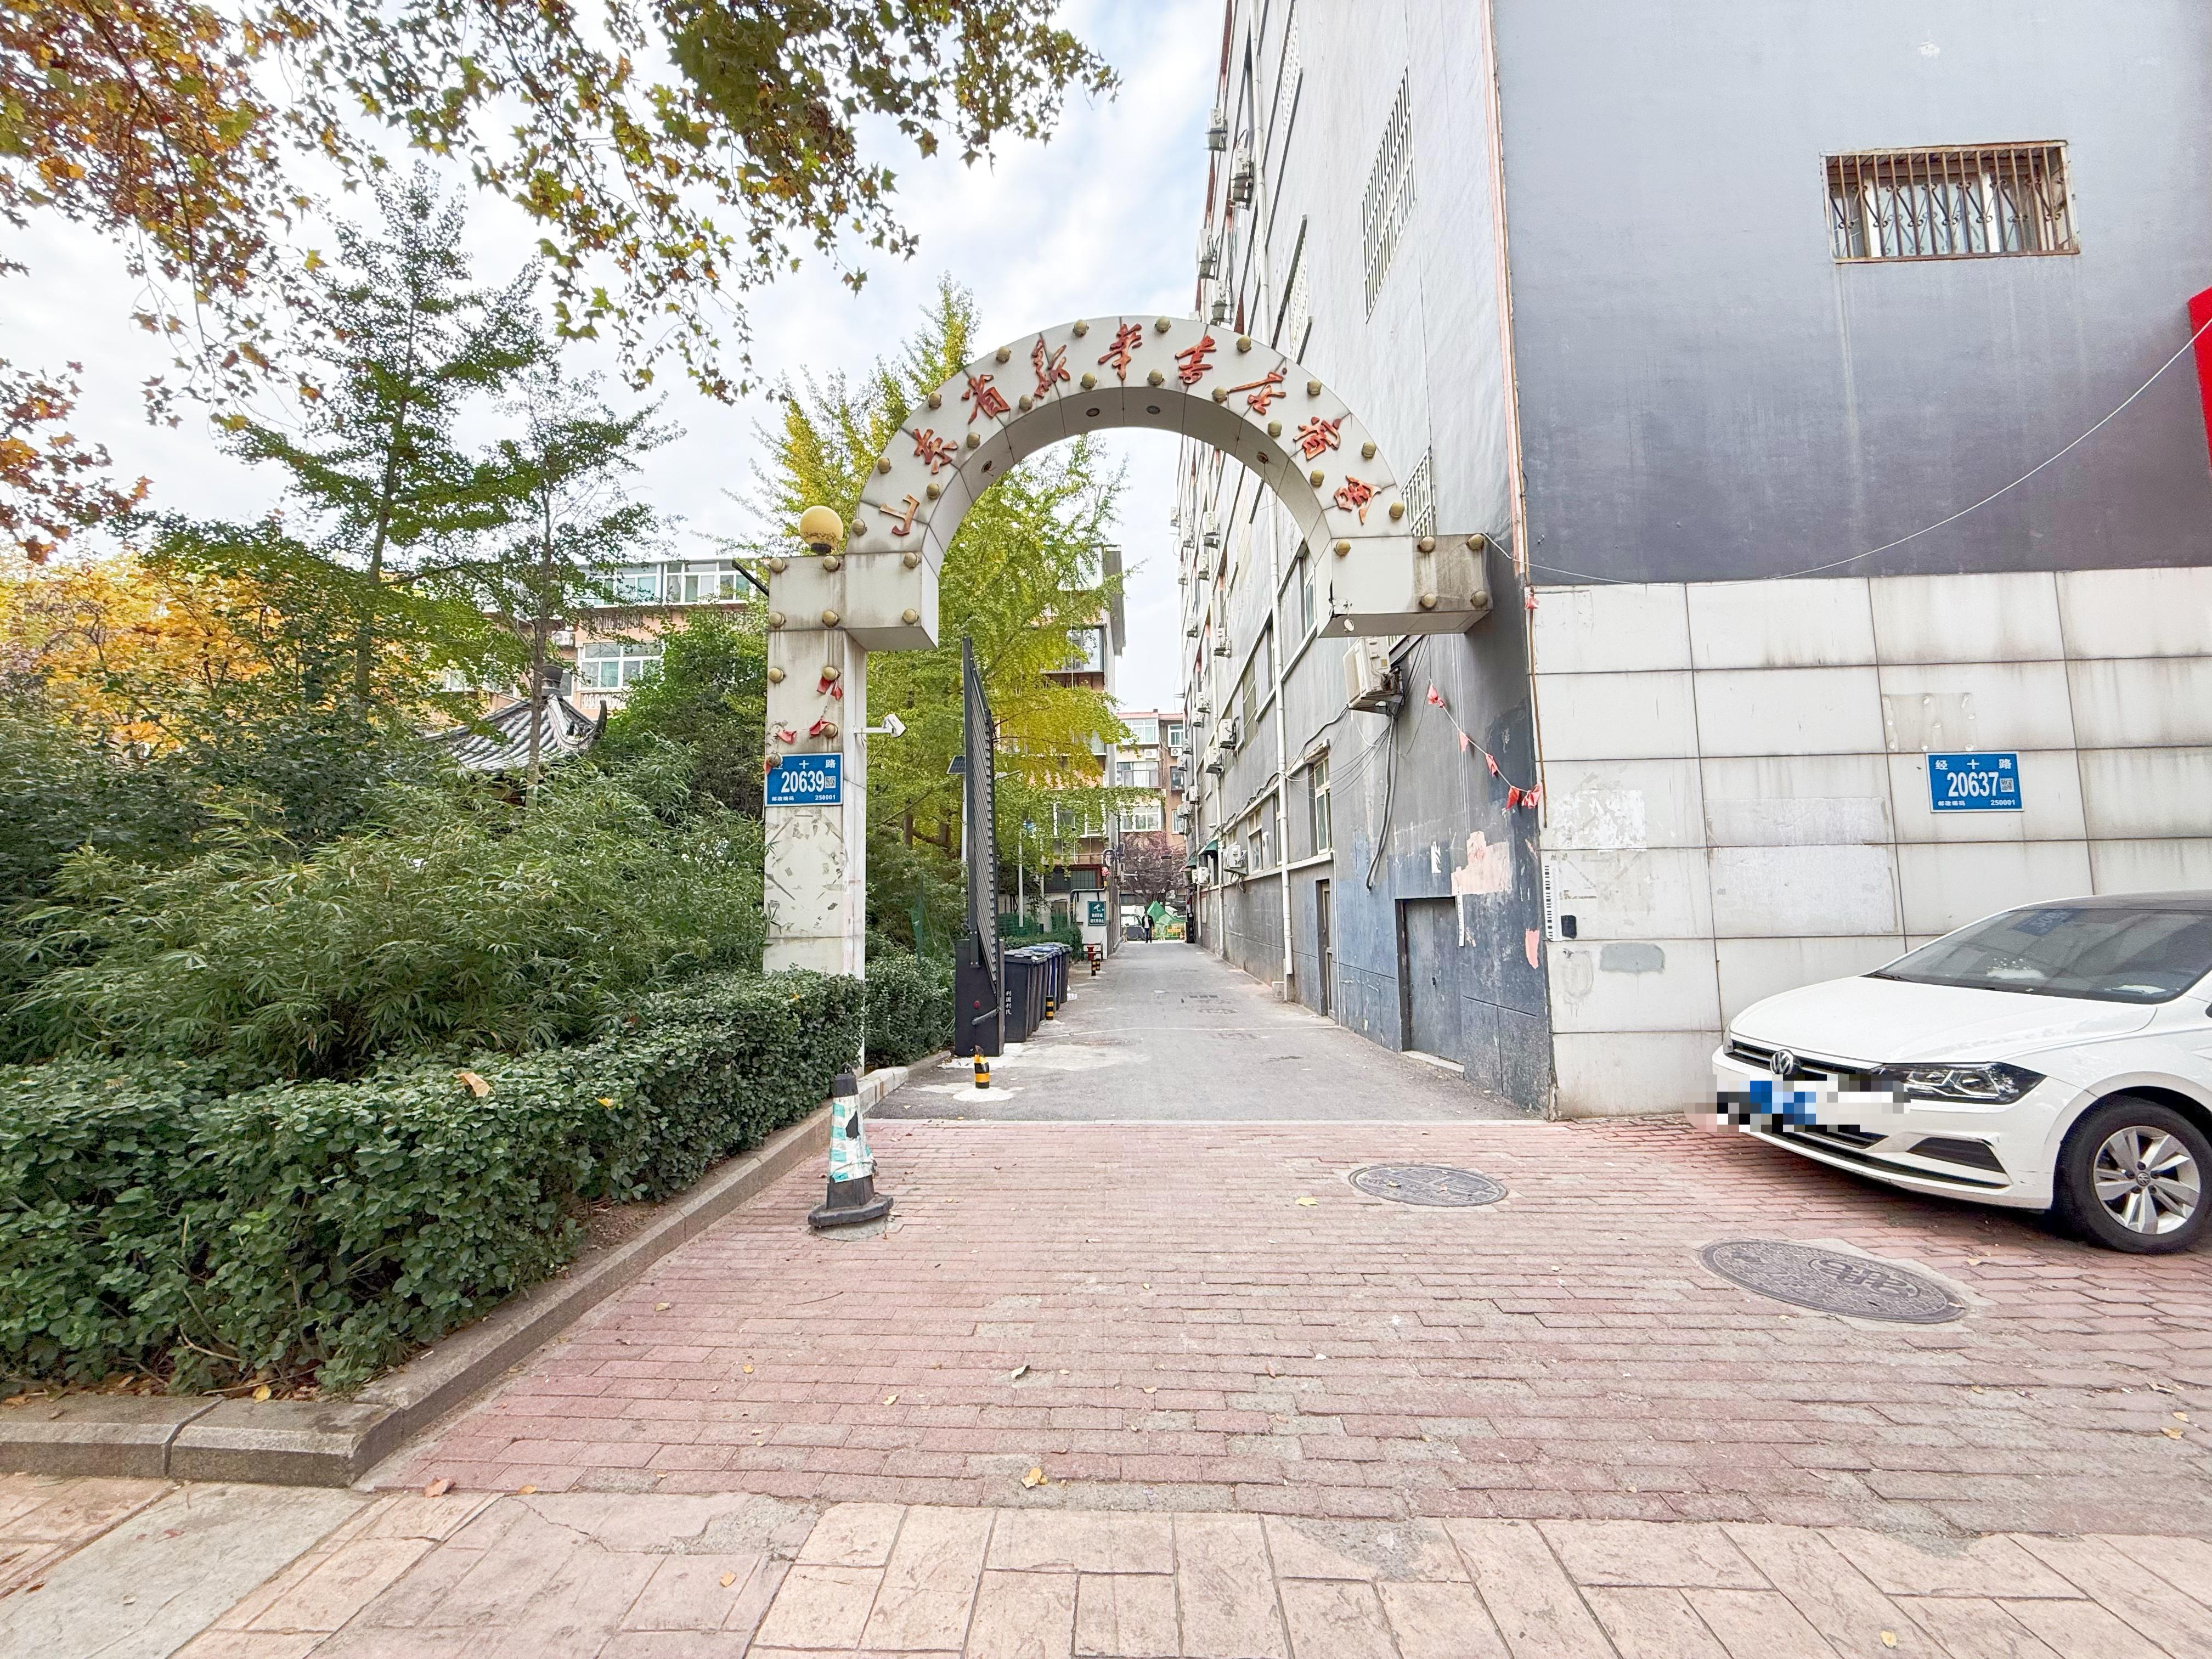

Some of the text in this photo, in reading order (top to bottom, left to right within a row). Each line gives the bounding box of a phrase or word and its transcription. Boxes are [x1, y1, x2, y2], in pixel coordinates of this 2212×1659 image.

[772, 759, 836, 770] 十路
[1935, 759, 2012, 770] 经十路
[781, 770, 825, 793] 20639
[1947, 771, 1999, 797] 20637
